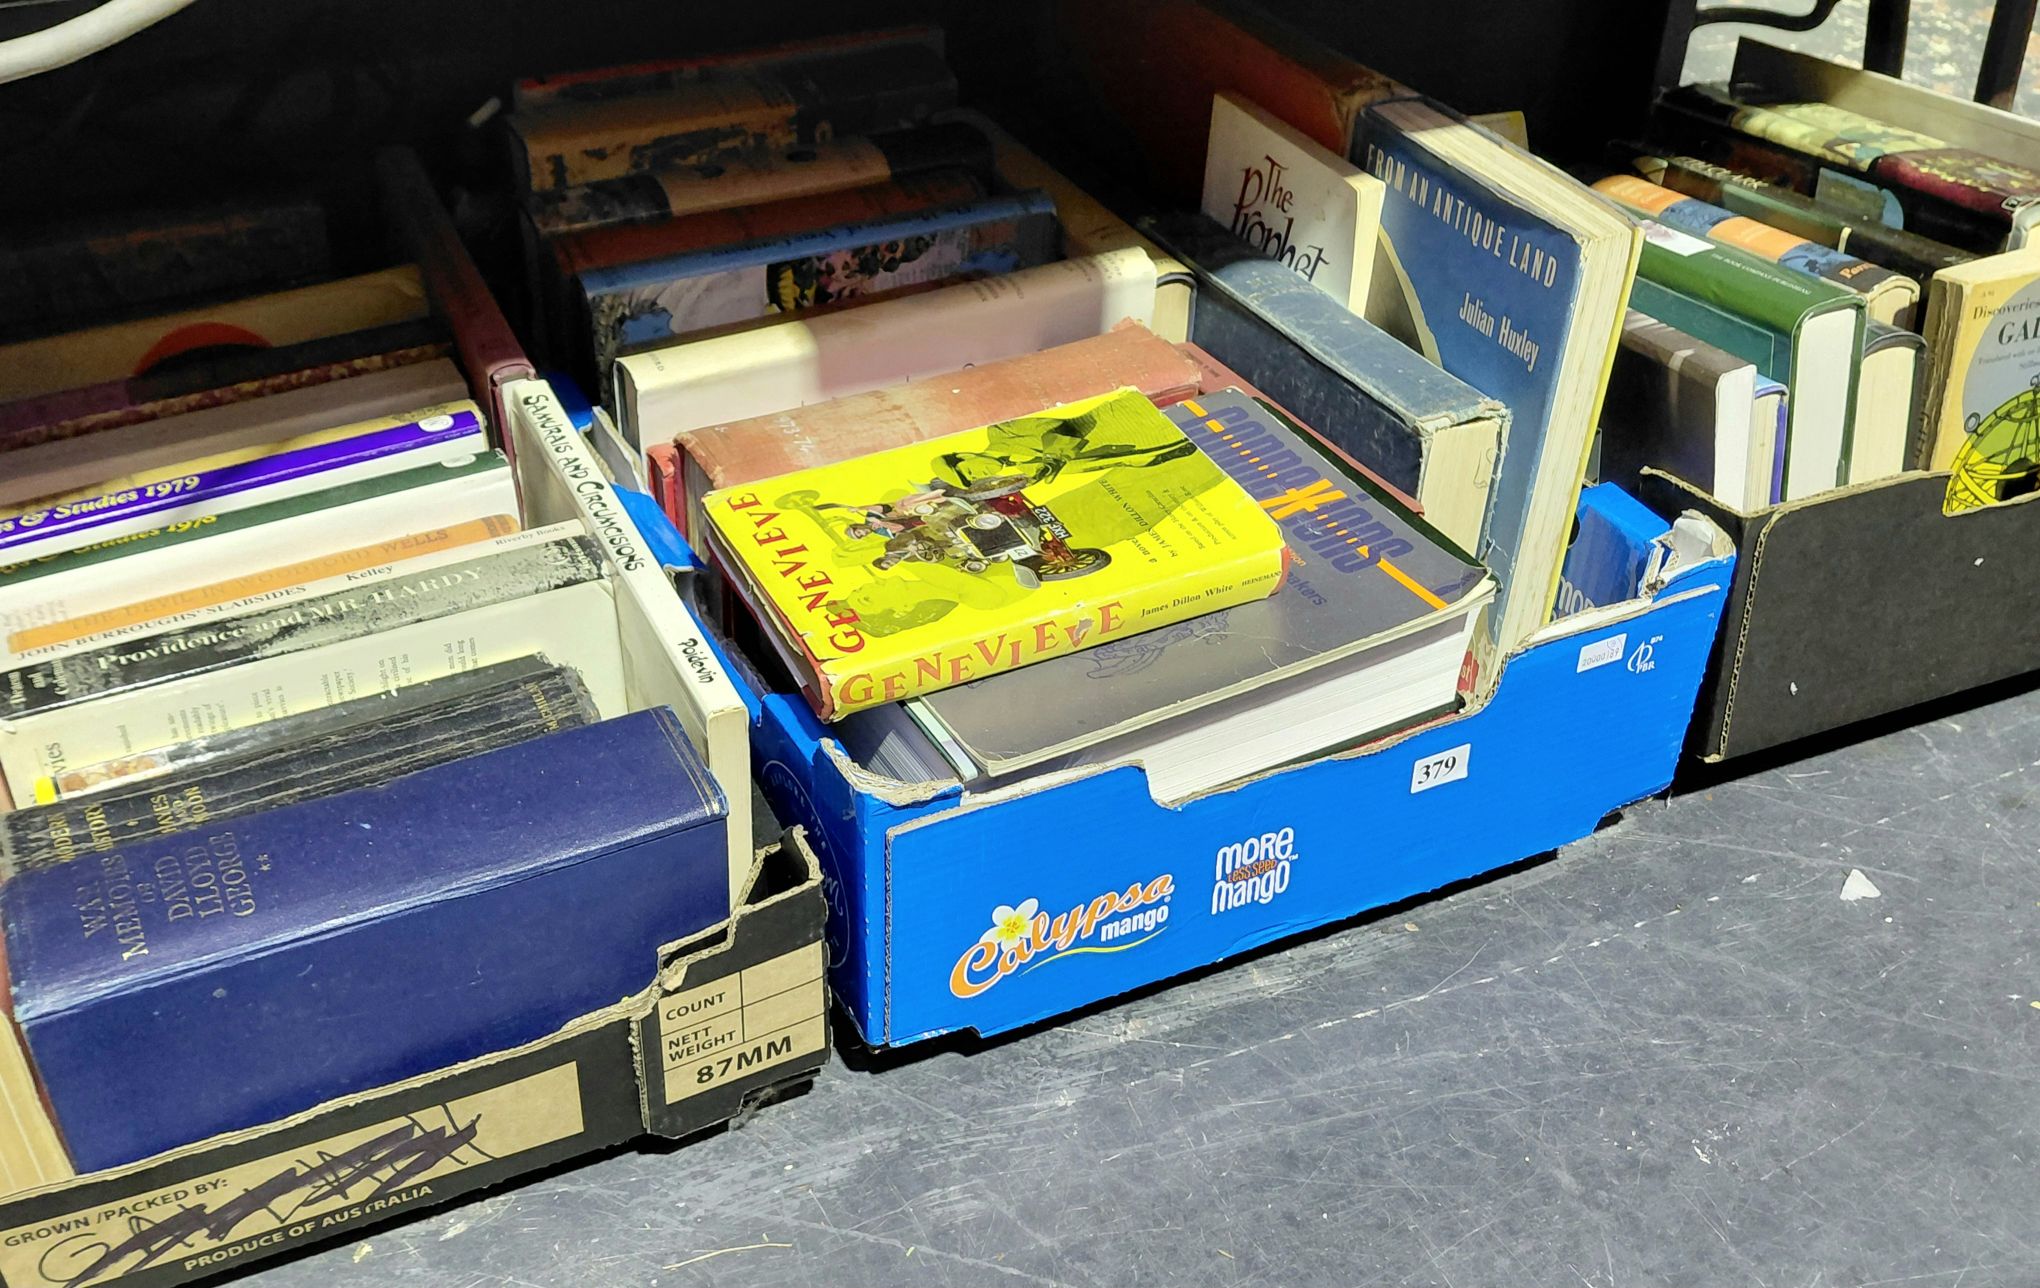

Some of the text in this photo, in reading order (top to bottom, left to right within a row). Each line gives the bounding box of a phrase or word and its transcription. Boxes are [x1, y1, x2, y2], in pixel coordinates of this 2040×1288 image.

[1264, 155, 1295, 215] The
[1367, 143, 1558, 289] FROM AN ANTIQUE LAND
[1460, 292, 1540, 372] Julian Huxley
[557, 456, 590, 479] AND
[1095, 477, 1124, 501] WHITE
[53, 490, 139, 520] Studies
[144, 476, 201, 497] 1979
[1117, 501, 1152, 530] DILLON
[238, 542, 373, 591] WOODFORD
[381, 528, 450, 556] WELLS
[1125, 535, 1151, 556] novel
[1144, 526, 1172, 549] JAMES
[17, 640, 71, 660] JOHN
[75, 610, 201, 648] BURROUGHS'
[206, 584, 307, 616] SLABSIDES
[346, 564, 394, 582] Kelley
[536, 524, 566, 539] Books
[727, 493, 866, 654] GENEVIEVE
[98, 624, 247, 670] Providence
[254, 610, 305, 634] and
[370, 565, 485, 606] HARDY
[1140, 583, 1234, 618] James Dillon White
[678, 638, 715, 684] Poidevin
[838, 601, 1125, 706] GENEVIEVE
[1417, 754, 1458, 785] 379
[154, 855, 195, 923] DAVID
[185, 845, 226, 919] LLOYD
[208, 830, 257, 917] GEORGE
[948, 873, 1176, 1000] Calypso
[1100, 905, 1169, 943] mango
[666, 991, 726, 1021] COUNT
[668, 1026, 712, 1050] NETT
[669, 1030, 737, 1062] WEIGHT
[696, 1035, 792, 1084] 87MM
[4, 1214, 91, 1249] GROWN
[195, 1177, 229, 1201] BY:
[184, 1230, 286, 1272] PRODUCE
[290, 1219, 315, 1239] OF
